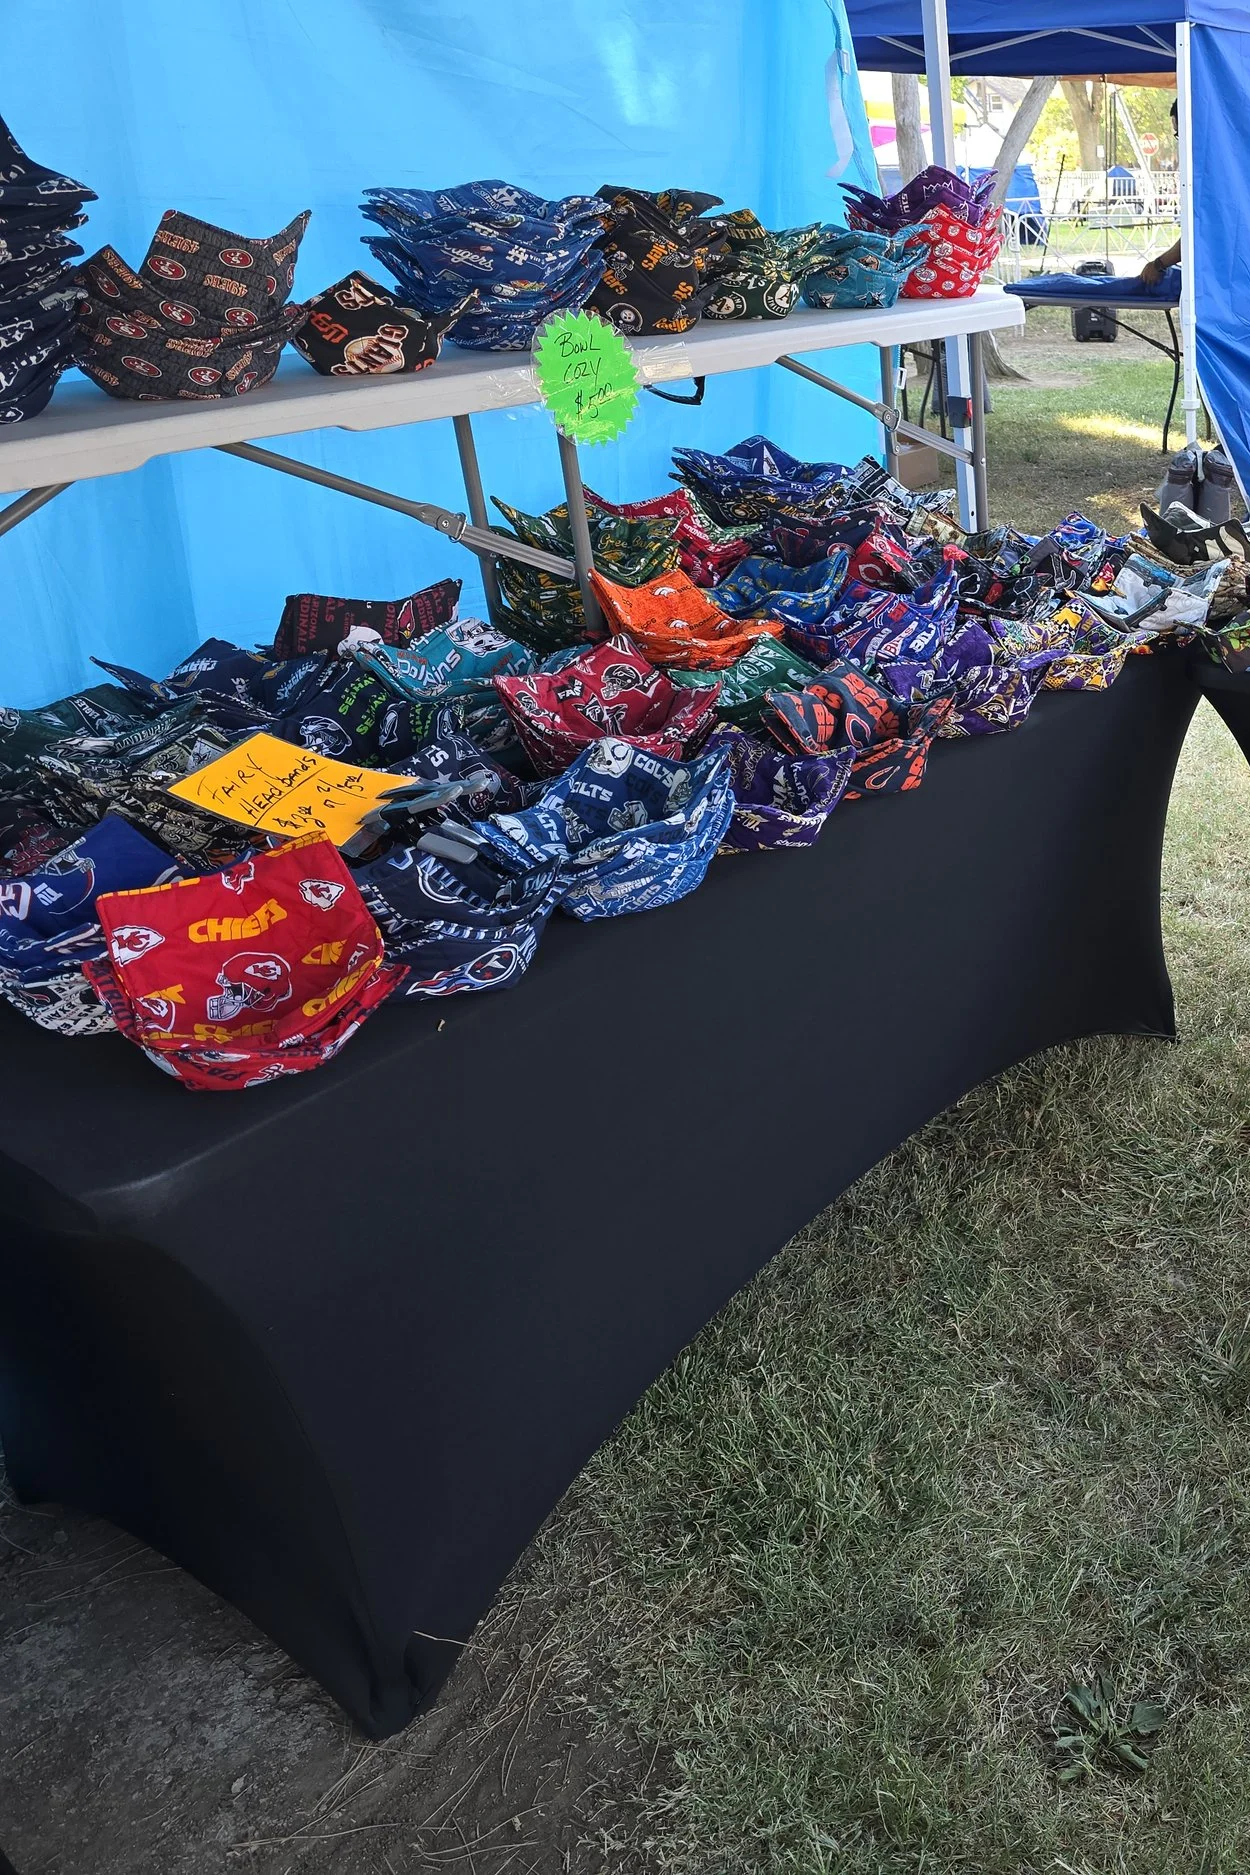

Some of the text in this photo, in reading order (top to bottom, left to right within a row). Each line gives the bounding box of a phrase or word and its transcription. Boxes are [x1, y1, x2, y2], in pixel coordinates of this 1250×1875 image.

[563, 357, 602, 390] COZY
[634, 753, 675, 788] COLTS
[188, 898, 288, 943] CHIEFS
